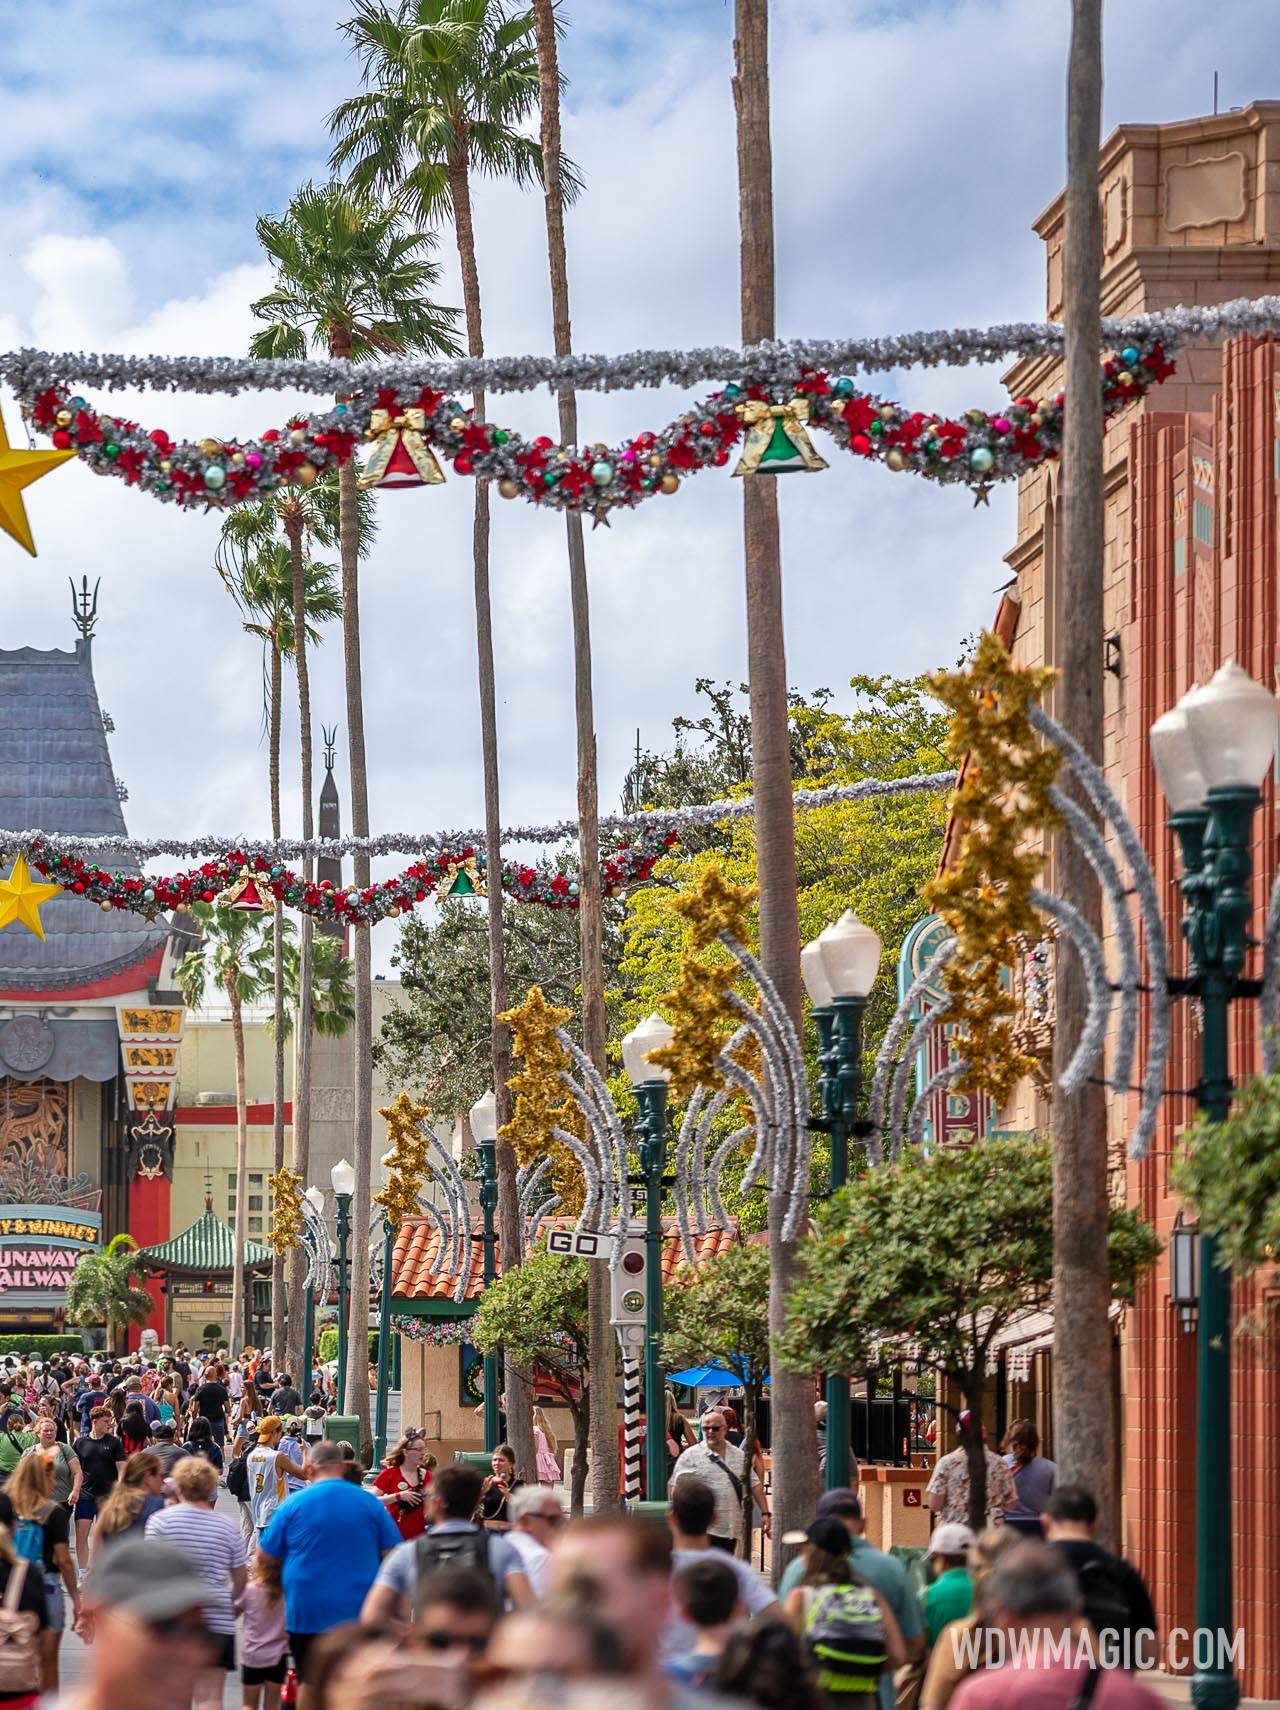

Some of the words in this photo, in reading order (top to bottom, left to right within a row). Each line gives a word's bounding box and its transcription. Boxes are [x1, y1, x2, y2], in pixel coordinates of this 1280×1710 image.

[15, 1219, 26, 1234] &
[29, 1220, 96, 1242] MINNIE'S
[550, 1232, 598, 1255] GO
